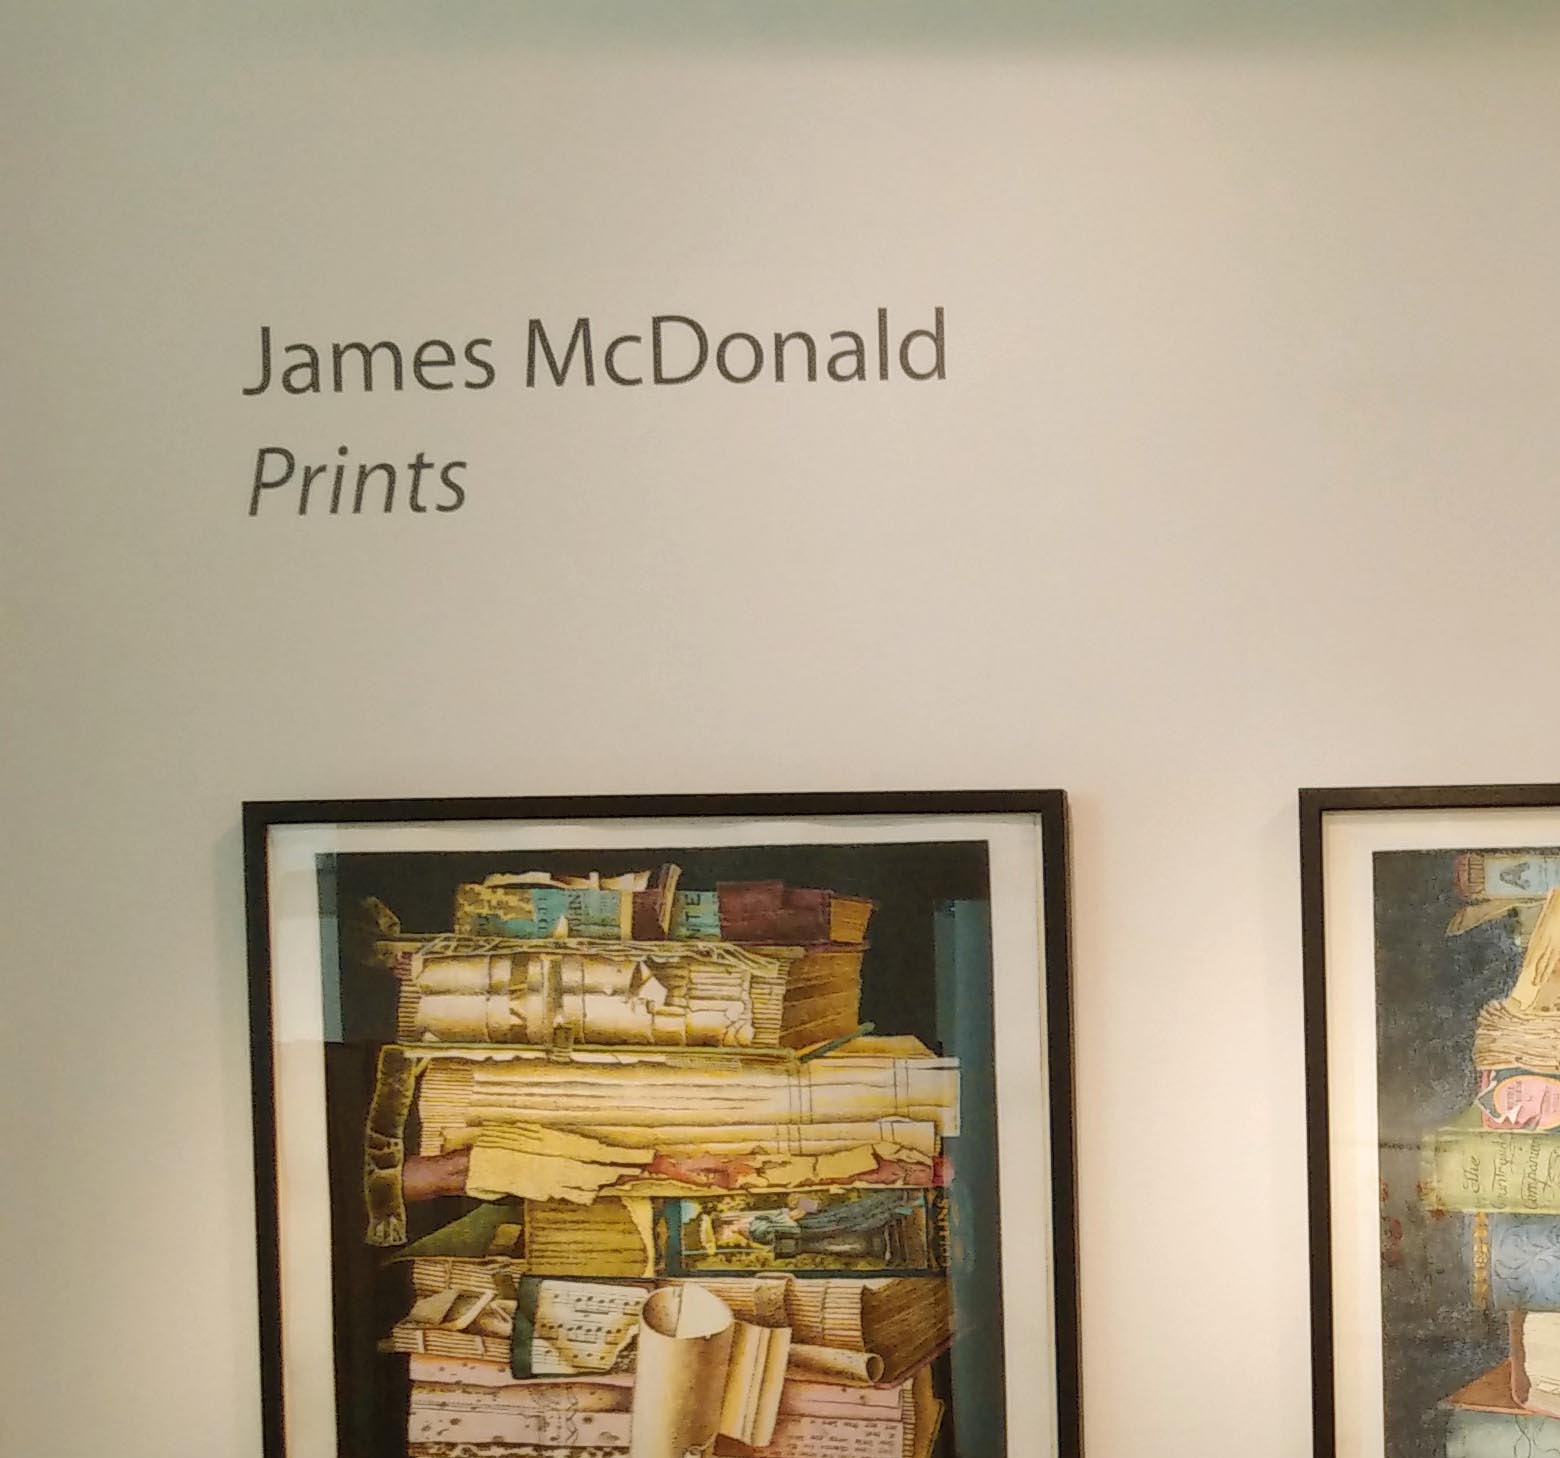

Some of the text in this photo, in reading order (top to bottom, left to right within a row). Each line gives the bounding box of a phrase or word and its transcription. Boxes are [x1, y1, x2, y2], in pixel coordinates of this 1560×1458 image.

[242, 306, 948, 396] James McDonald
[248, 444, 468, 517] Prints
